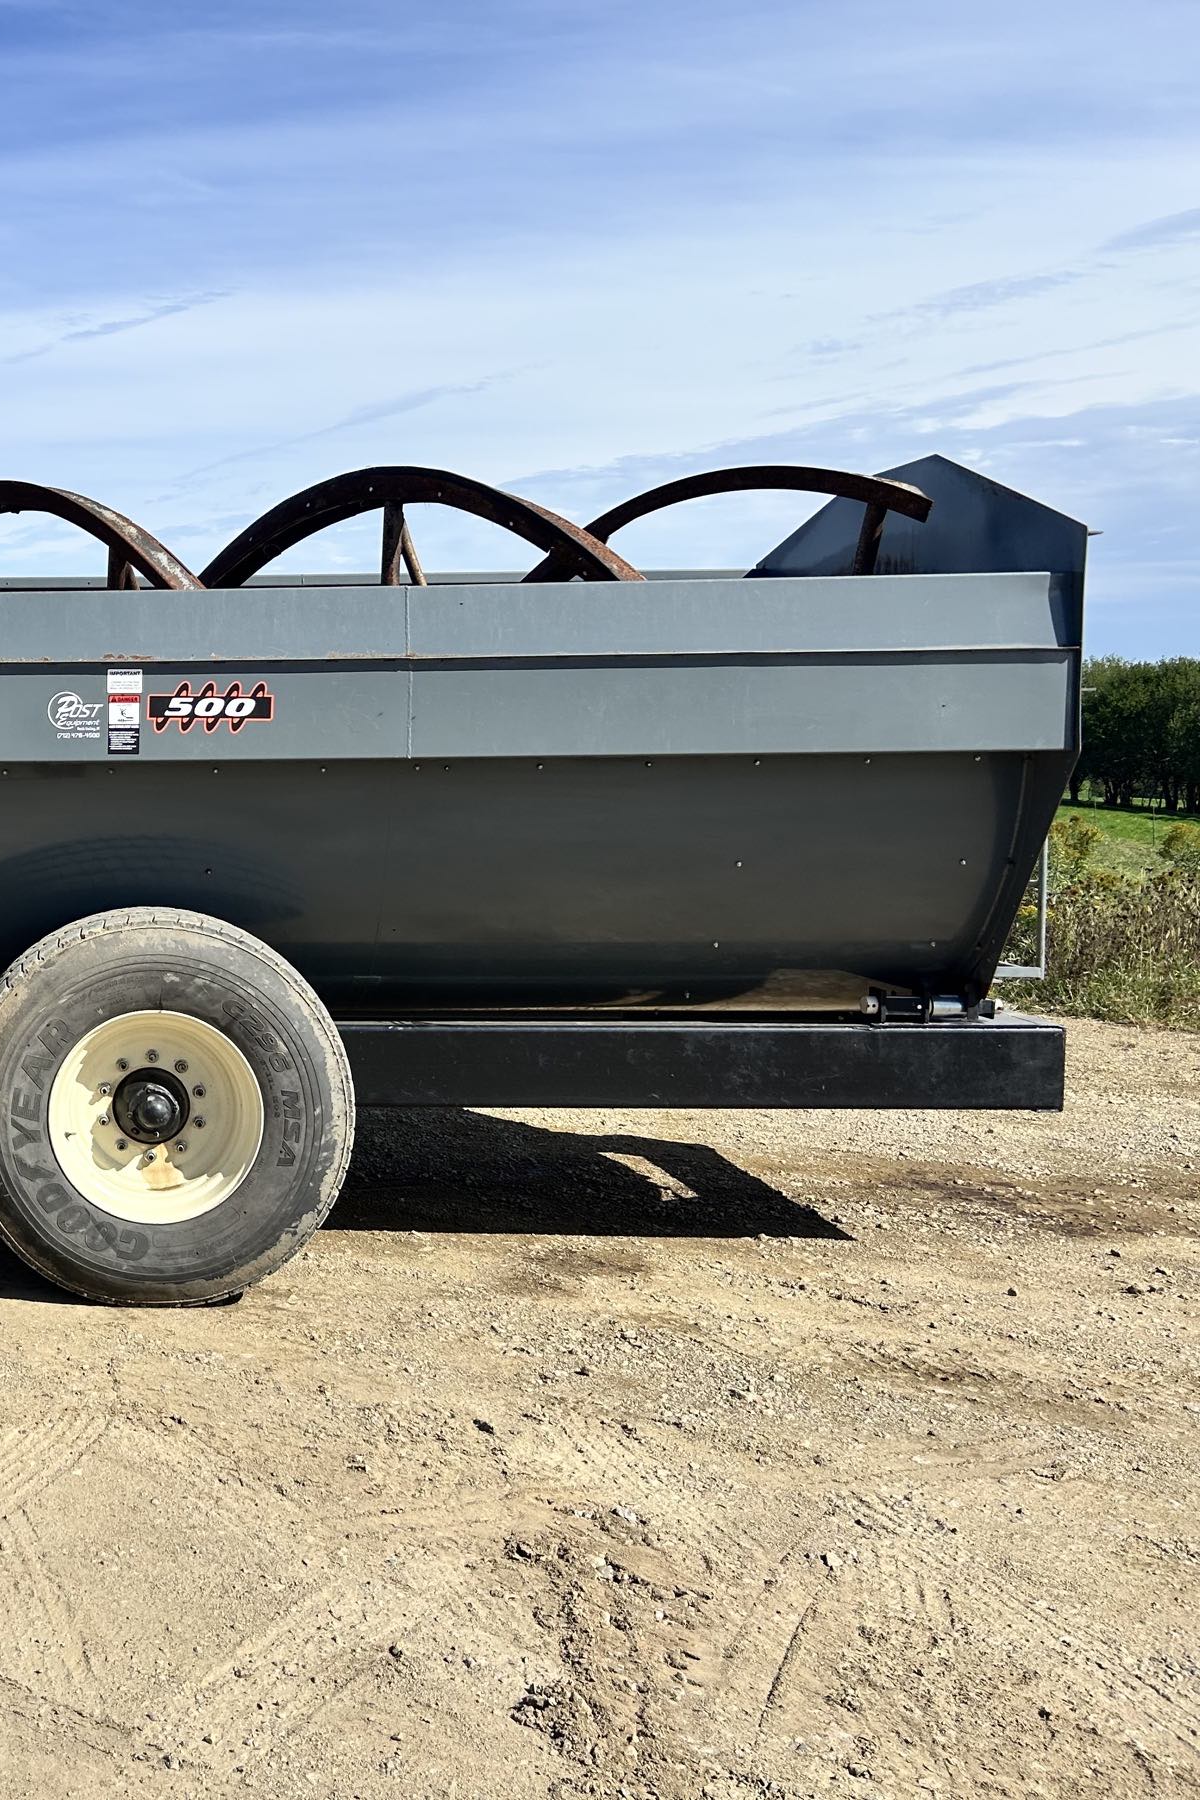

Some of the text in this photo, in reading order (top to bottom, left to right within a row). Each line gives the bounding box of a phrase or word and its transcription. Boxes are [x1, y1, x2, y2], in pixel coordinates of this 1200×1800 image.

[55, 695, 104, 719] POST
[164, 697, 257, 718] 500
[57, 713, 100, 727] Equipment
[10, 1018, 149, 1261] GOODYEAR
[276, 1089, 301, 1167] MSA
